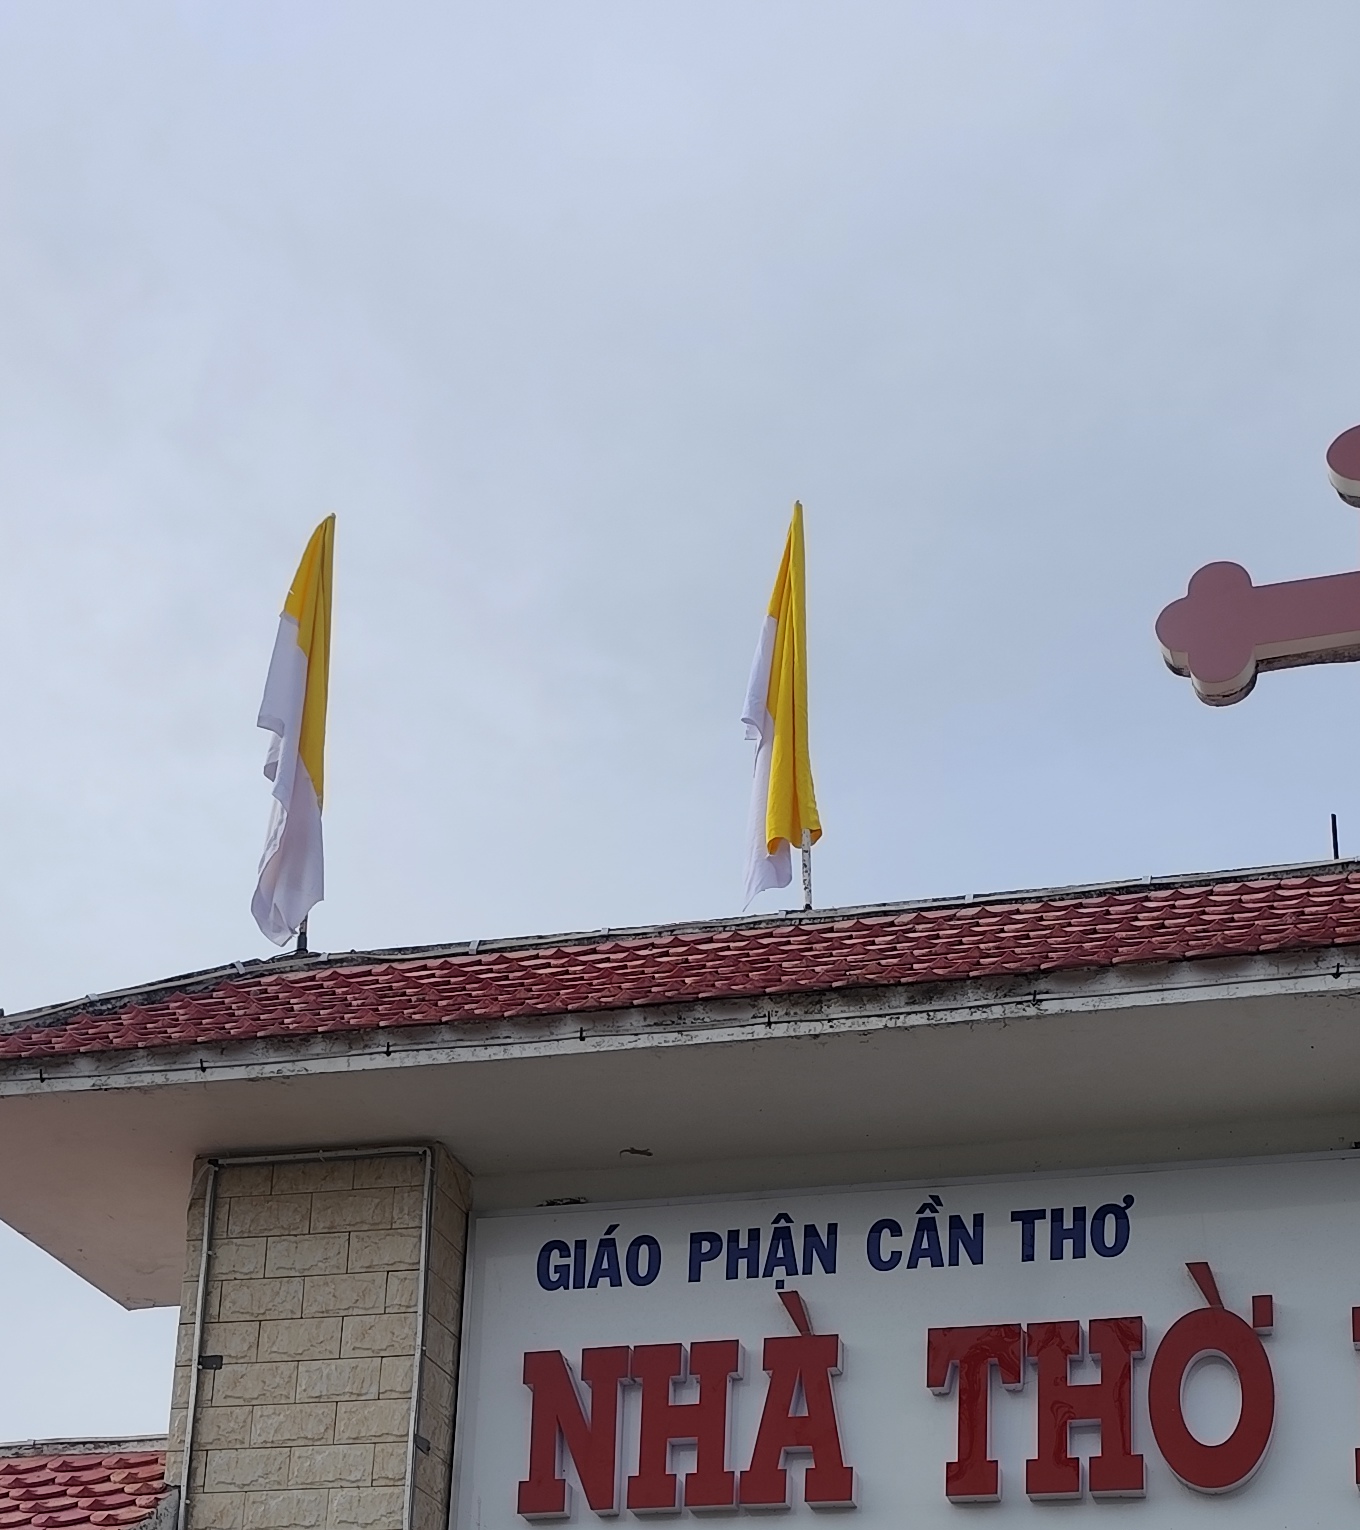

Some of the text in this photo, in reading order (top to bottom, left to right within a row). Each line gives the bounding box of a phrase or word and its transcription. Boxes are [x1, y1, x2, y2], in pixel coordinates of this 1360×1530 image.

[535, 1194, 1135, 1291] GIÁO PHẬN CẦN THƠ
[516, 1289, 856, 1520] NHÀ
[925, 1261, 1275, 1502] THỜ
